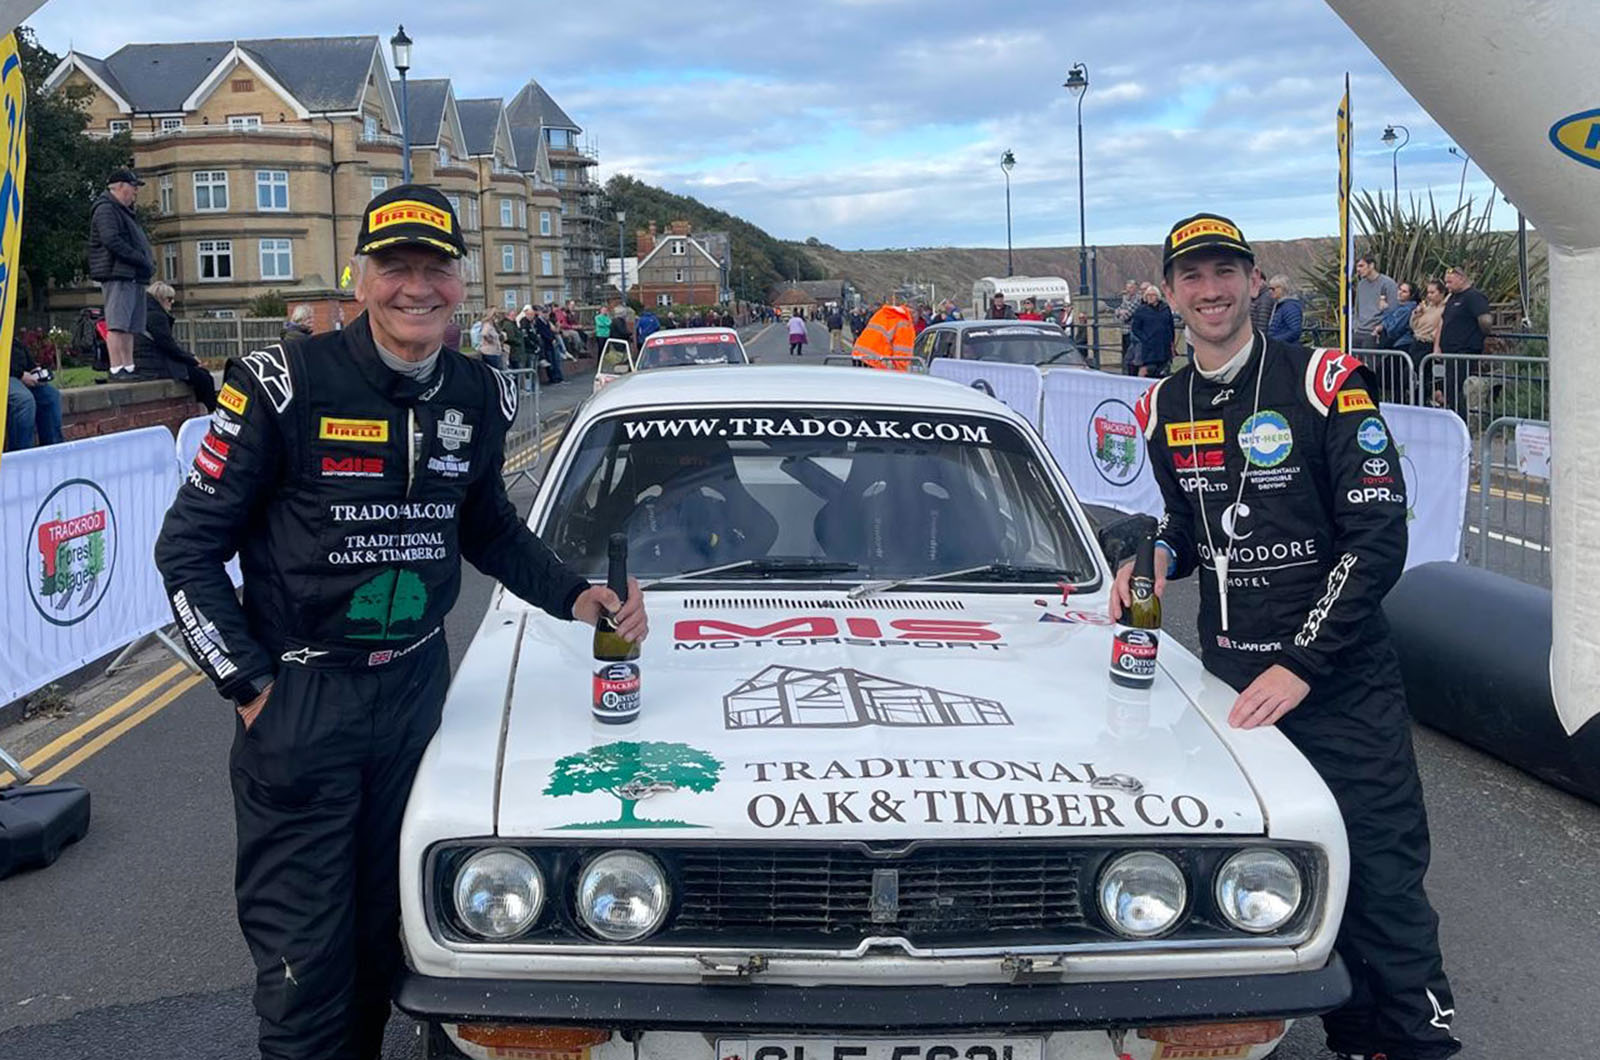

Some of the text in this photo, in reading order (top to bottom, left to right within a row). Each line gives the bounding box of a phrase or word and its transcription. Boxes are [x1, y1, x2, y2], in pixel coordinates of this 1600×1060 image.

[375, 205, 444, 226] PIRELLI
[326, 422, 381, 437] PIRELLI
[623, 418, 992, 443] WWW.TRADOAK.COM
[1170, 425, 1219, 441] PIRELLI
[321, 457, 384, 472] MIS
[49, 514, 101, 541] TRACKROD
[345, 533, 444, 548] TRADITIONAL
[58, 541, 93, 568] Forest
[328, 551, 364, 564] OAK
[57, 567, 95, 593] Stages
[1227, 576, 1270, 587] HOTEL
[173, 590, 197, 630] SILVER
[190, 626, 215, 654] FERN
[207, 648, 238, 679] RALLY
[673, 617, 1001, 640] MIS
[674, 637, 1008, 651] MOTORSPORT
[745, 757, 1100, 783] TRADITIONAL
[747, 789, 1224, 829] OAK & TIMBER CO.
[1161, 1045, 1241, 1058] PIRELLI
